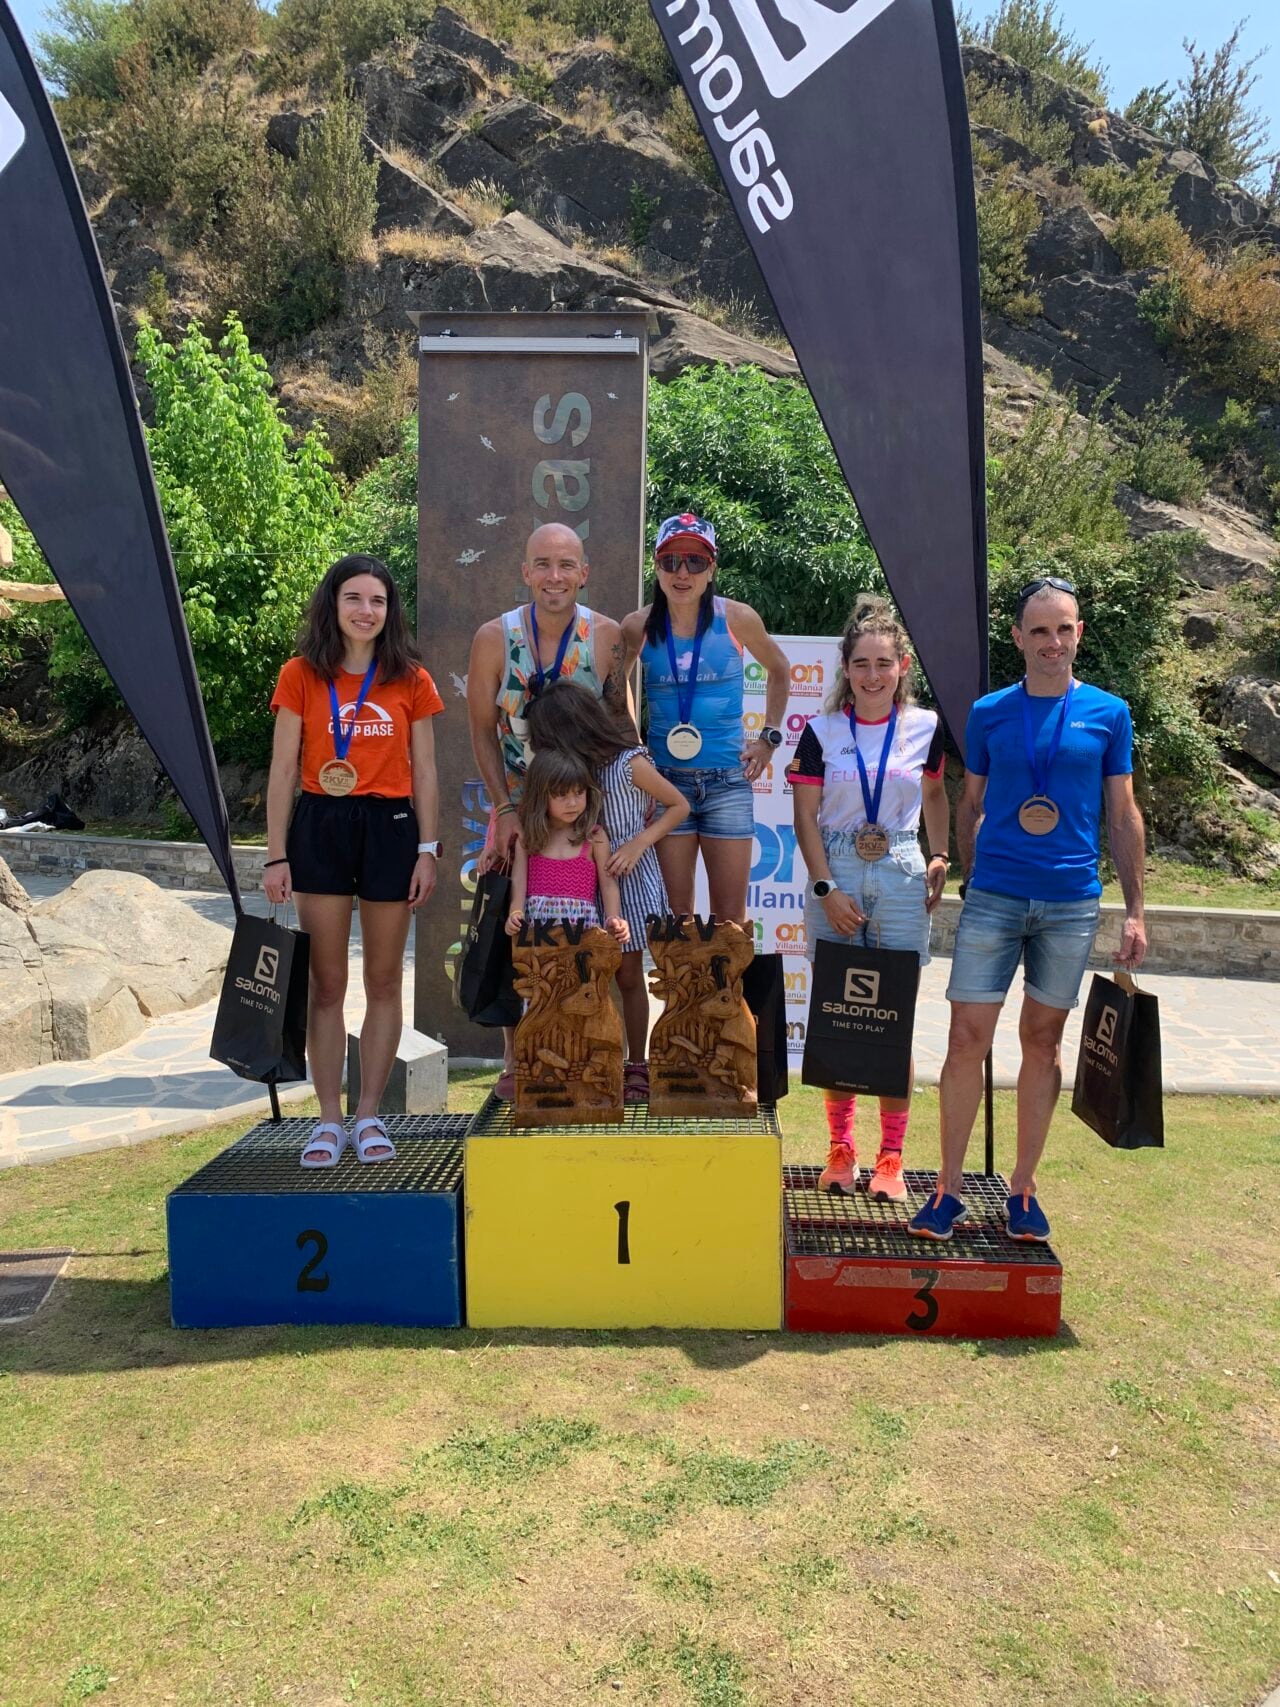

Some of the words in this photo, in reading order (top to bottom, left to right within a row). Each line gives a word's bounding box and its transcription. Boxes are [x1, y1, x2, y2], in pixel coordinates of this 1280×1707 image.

[659, 673, 719, 683] RADLGHT
[790, 664, 824, 683] on
[789, 683, 823, 692] Villanúa
[363, 723, 395, 737] BASE
[234, 976, 281, 1005] salomon
[240, 996, 255, 1008] TIME
[255, 1001, 264, 1010] TO
[822, 1002, 898, 1021] salomon
[832, 1020, 851, 1029] TIME
[853, 1022, 864, 1031] TO
[865, 1024, 885, 1033] PLAY
[1083, 1034, 1119, 1067] salomon
[613, 1200, 631, 1265] 1
[296, 1228, 330, 1293] 2
[905, 1267, 940, 1332] 3
